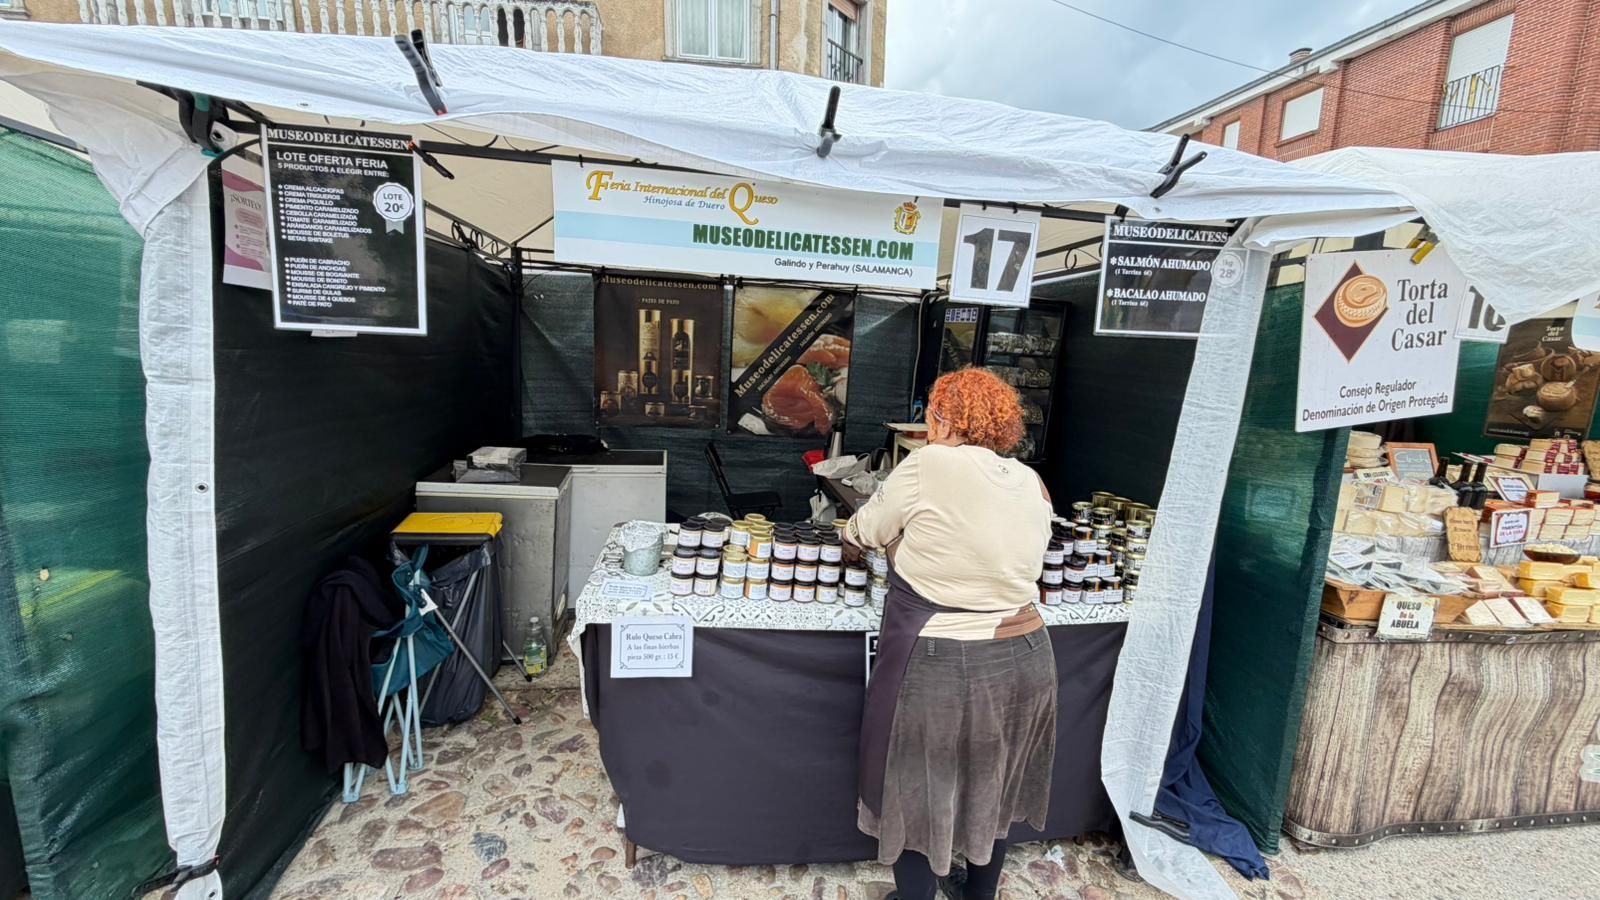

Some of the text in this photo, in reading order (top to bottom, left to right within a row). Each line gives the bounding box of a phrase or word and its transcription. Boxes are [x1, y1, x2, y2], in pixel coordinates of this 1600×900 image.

[267, 128, 410, 150] MUSEODELICATESSEN
[276, 151, 388, 169] LOTE OFERTA FERIA
[283, 162, 329, 173] PRODUCTOS
[336, 167, 363, 176] ELEGIR
[363, 170, 390, 178] ENTRE:
[305, 186, 344, 195] ALCACHOFAS
[383, 193, 403, 201] LOTE
[586, 169, 779, 226] Feria Internacional del Queso
[285, 203, 359, 215] PIMIENTO CARAMELIZADO
[384, 202, 404, 213] 20€
[643, 195, 726, 211] Hinojosa de Duero
[312, 218, 358, 227] CARAMELIZADO
[313, 212, 358, 221] CARAMELIZADA
[692, 223, 914, 261] MUSEODELICATESSEN.COM
[1113, 224, 1231, 243] MUSEODELICATESS
[774, 257, 914, 278] Galindo y Perahuy (SALAMANCA)
[964, 227, 1032, 293] 17
[1118, 254, 1211, 271] SALMÓN AHUMADO
[291, 275, 316, 283] MOUSSE
[1113, 288, 1206, 303] BACALAO AHUMADO
[1397, 278, 1448, 302] Torta
[1406, 302, 1434, 326] del
[734, 293, 836, 398] Museodelicatessen.com
[1391, 329, 1448, 352] Casar
[1339, 378, 1417, 399] Consejo Regulador
[1302, 391, 1449, 422] Denominación de Origen Protegida
[1396, 600, 1422, 611] QUESO
[1390, 619, 1420, 629] ABUELA
[626, 632, 682, 642] Rulo Queso Cabra
